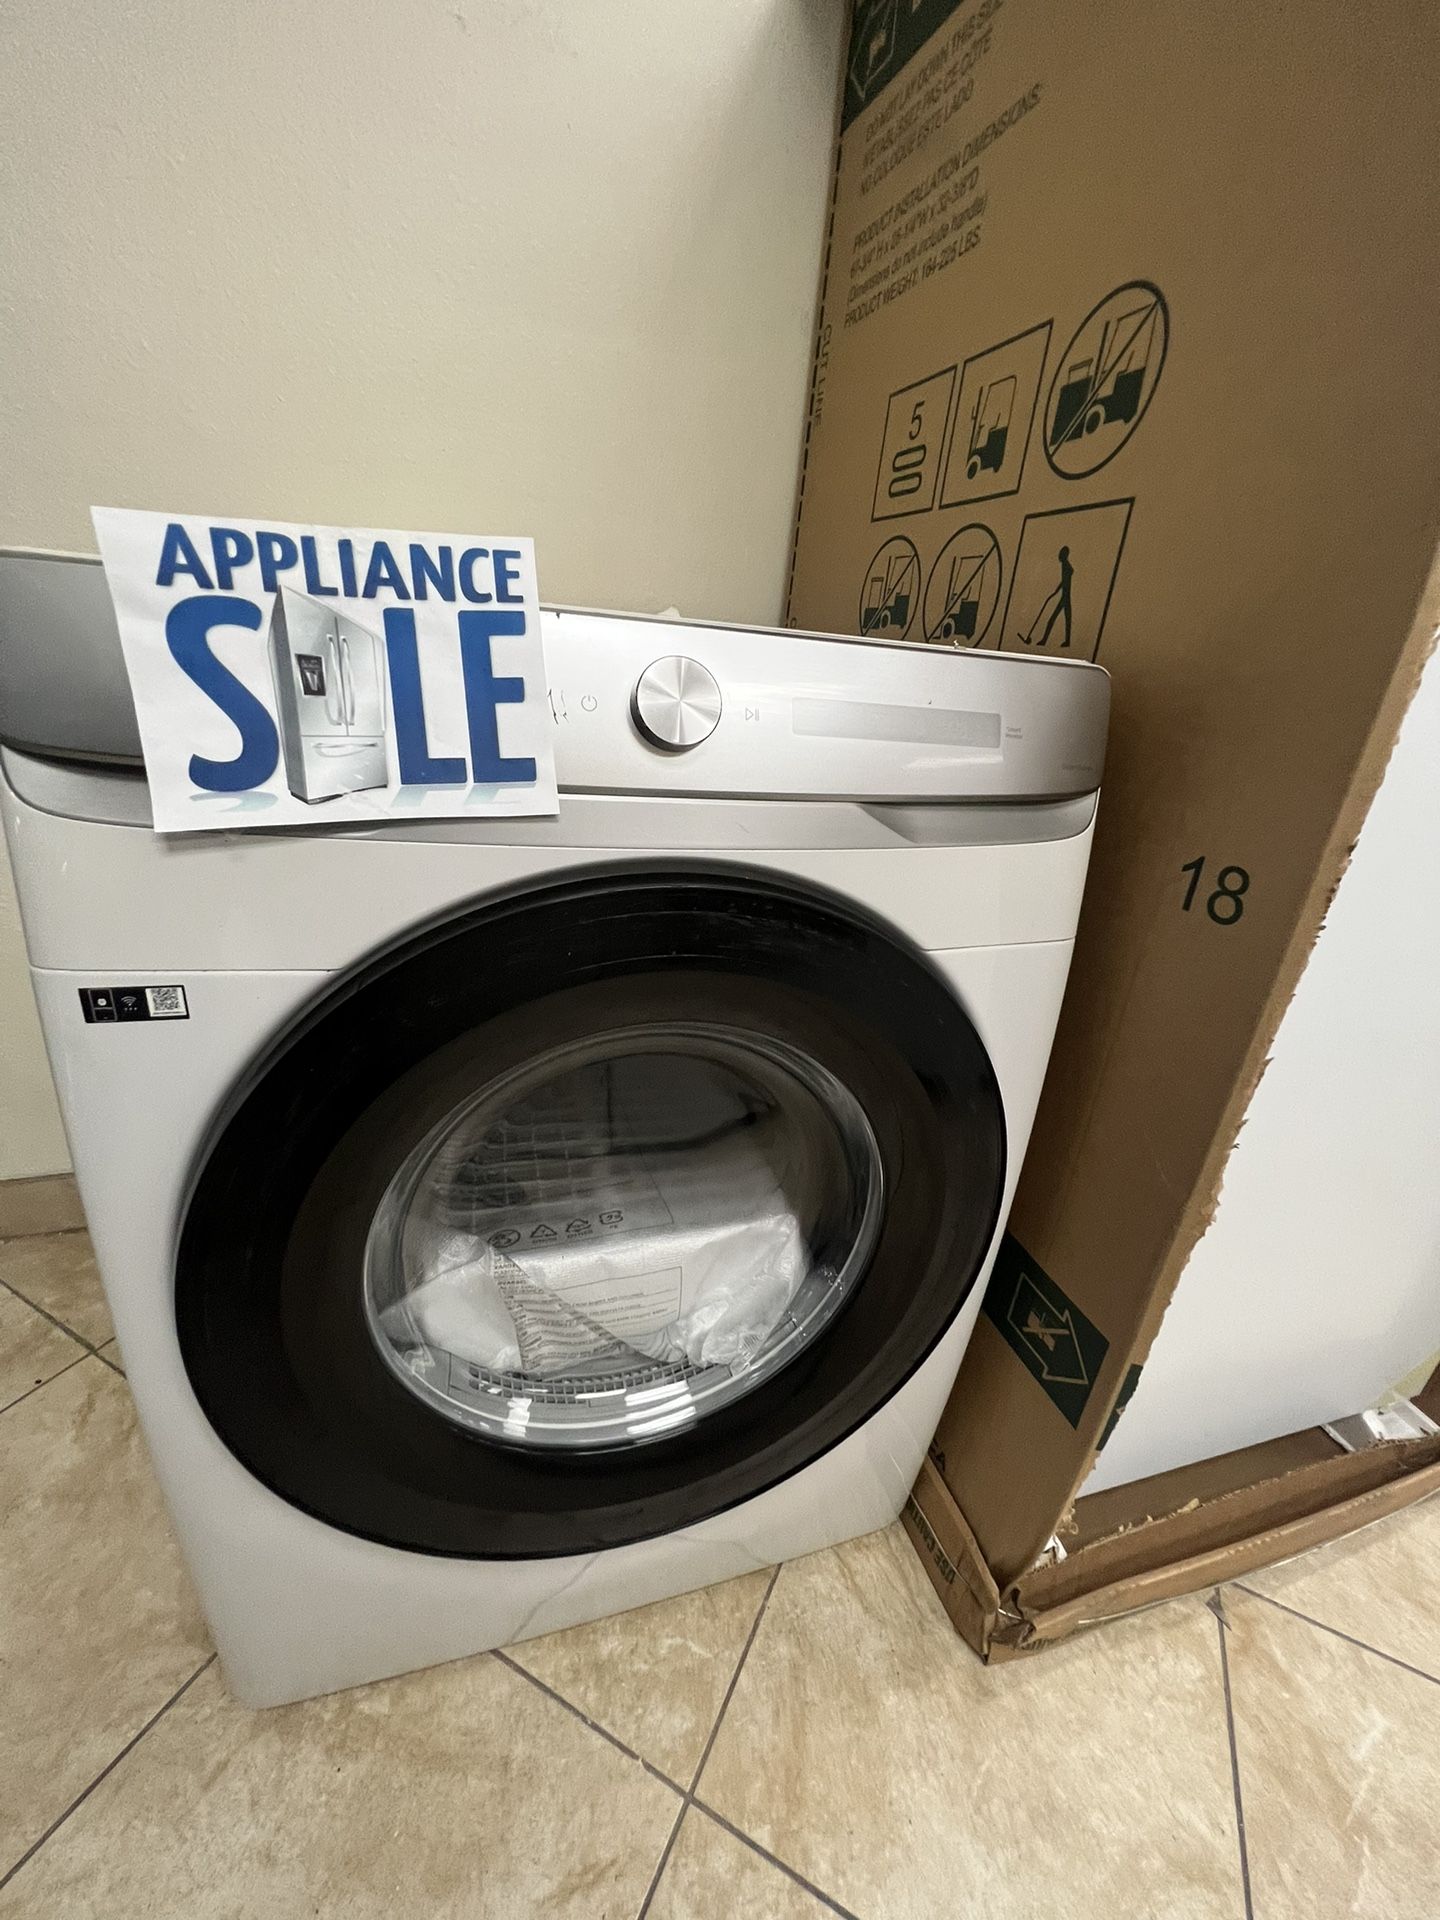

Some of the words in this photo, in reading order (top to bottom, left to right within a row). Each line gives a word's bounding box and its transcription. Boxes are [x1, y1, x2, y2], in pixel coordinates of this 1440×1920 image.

[852, 205, 895, 255] PRODUCT
[961, 82, 1042, 169] DIMENSIONS
[843, 289, 883, 330] PRODUCT
[908, 400, 926, 441] 5
[154, 522, 525, 604] APPLIANCE
[1180, 855, 1251, 926] 18
